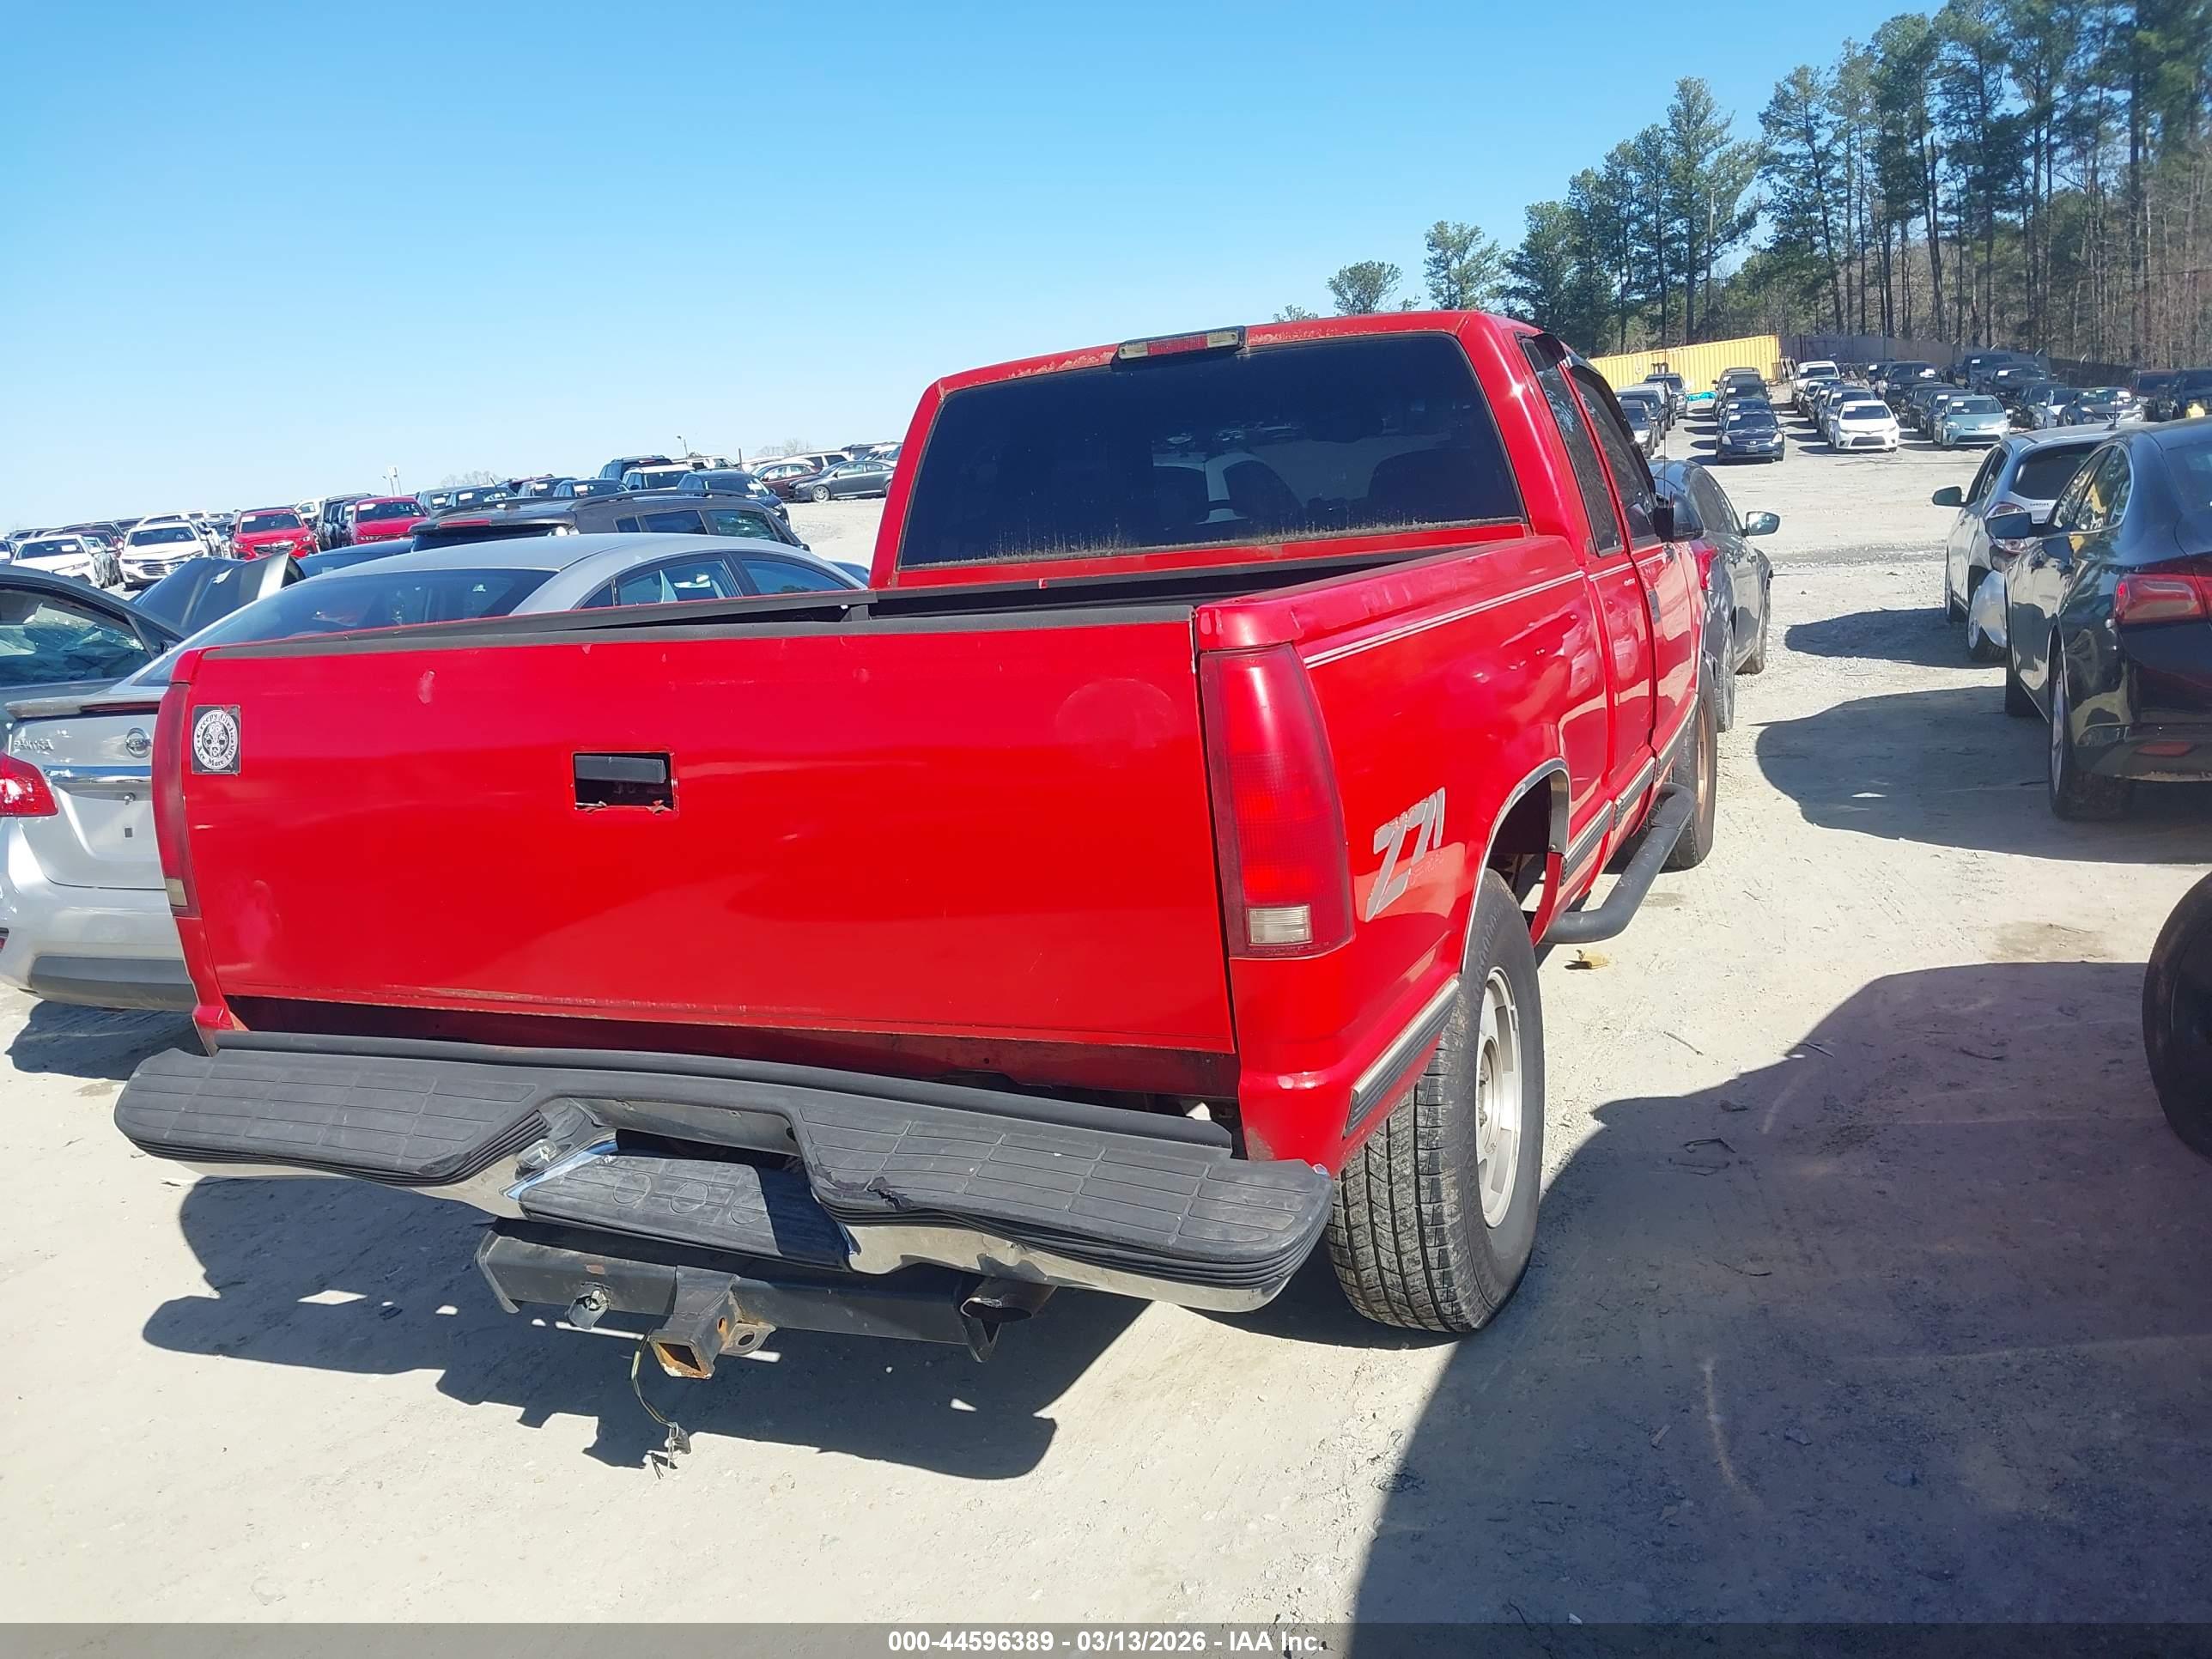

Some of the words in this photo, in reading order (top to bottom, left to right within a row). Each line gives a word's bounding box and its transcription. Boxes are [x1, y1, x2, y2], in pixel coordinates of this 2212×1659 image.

[196, 713, 218, 738] Creepy
[207, 757, 225, 767] More
[1365, 786, 1446, 923] Z71
